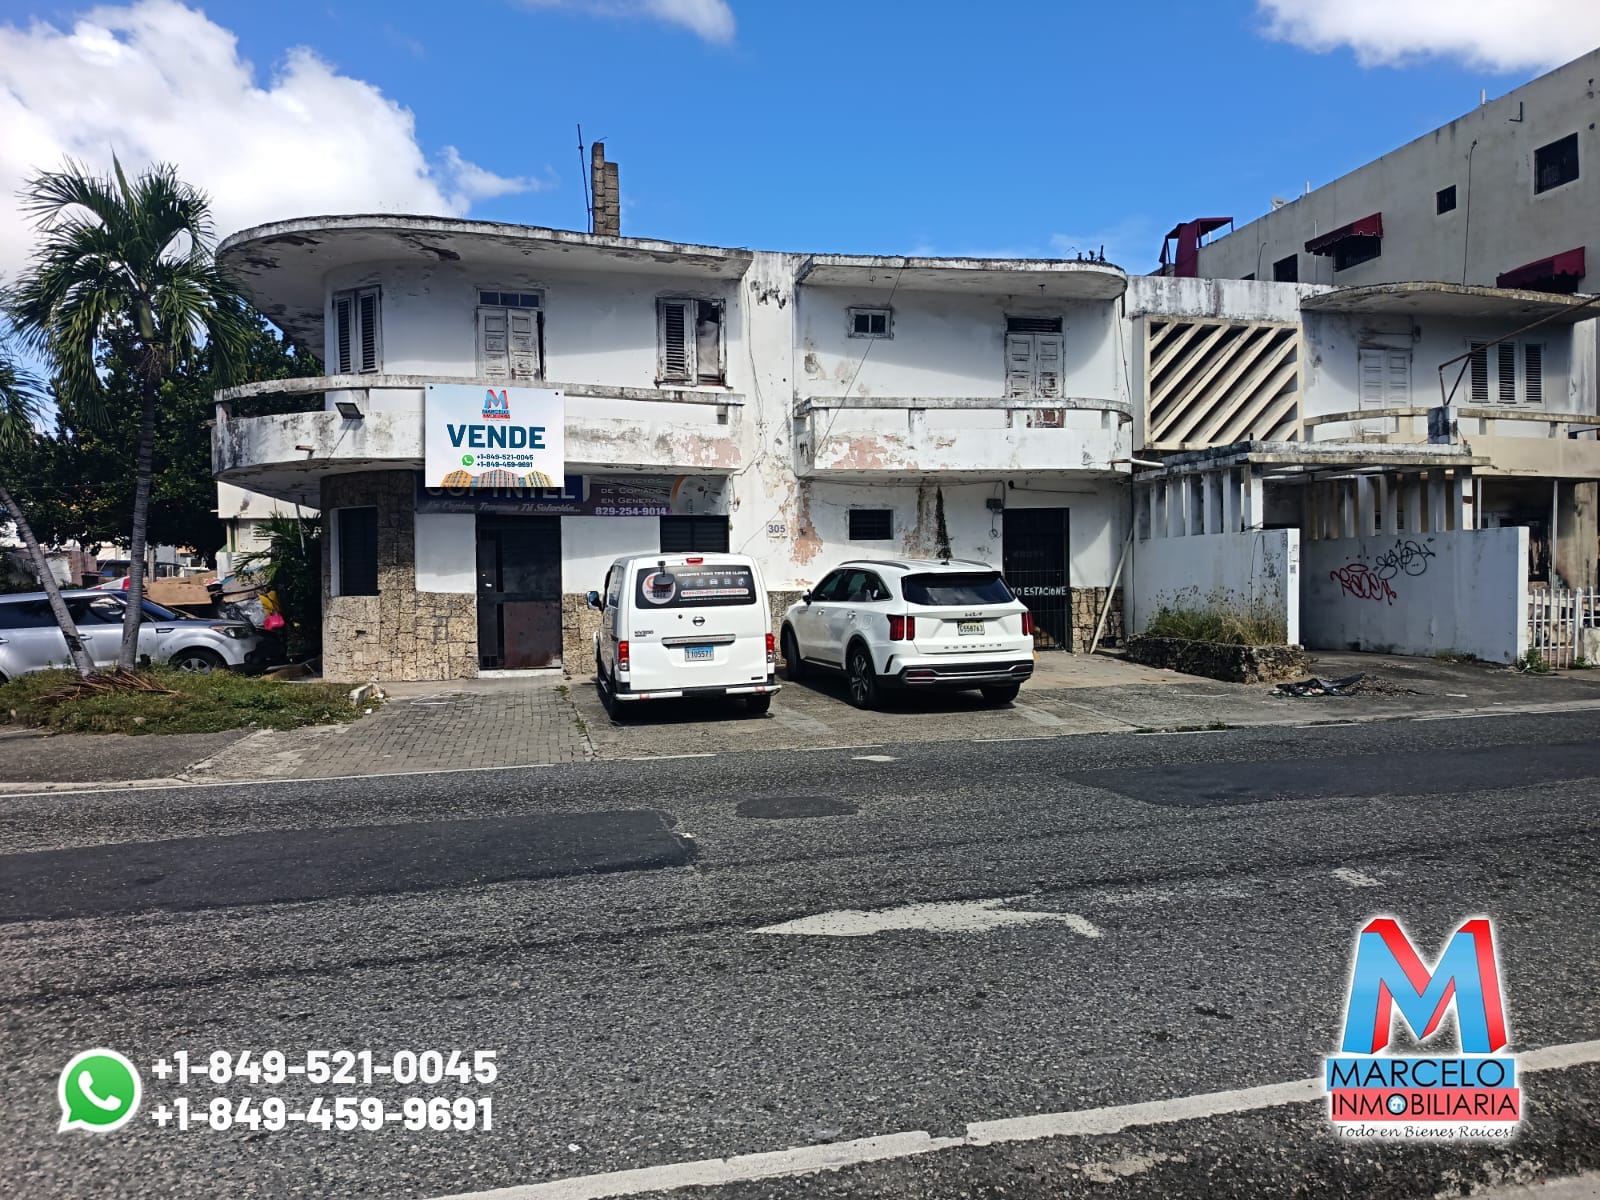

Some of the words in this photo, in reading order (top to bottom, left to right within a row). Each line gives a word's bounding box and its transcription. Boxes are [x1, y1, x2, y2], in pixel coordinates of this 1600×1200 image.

[446, 424, 546, 450] VENDE
[595, 506, 667, 515] 829-254-9014
[768, 524, 786, 534] 305
[1023, 586, 1068, 596] ESTACIONE
